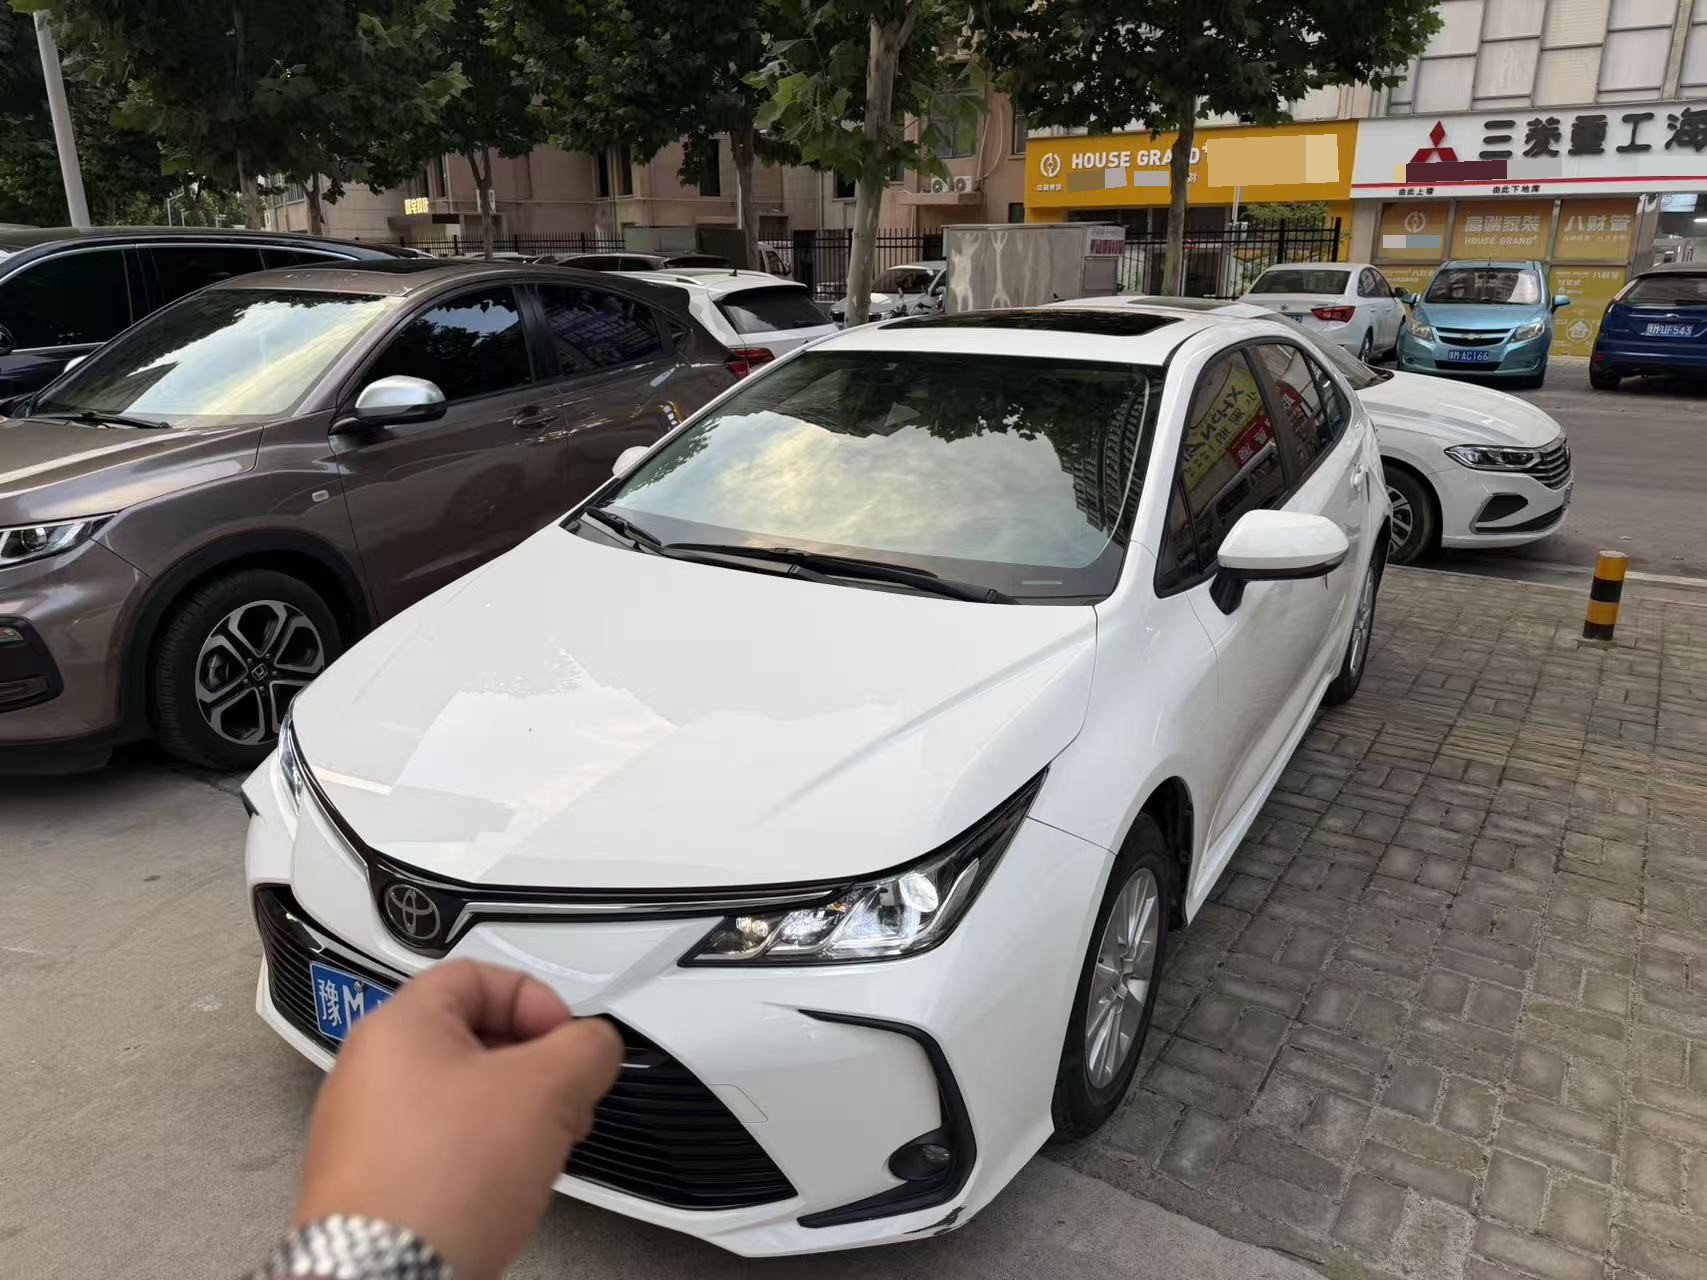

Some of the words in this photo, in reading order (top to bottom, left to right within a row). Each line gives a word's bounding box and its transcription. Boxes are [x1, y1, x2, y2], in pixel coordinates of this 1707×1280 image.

[1072, 151, 1131, 169] HOUSE
[1137, 147, 1202, 167] GRAD
[1465, 236, 1497, 245] HOUSE
